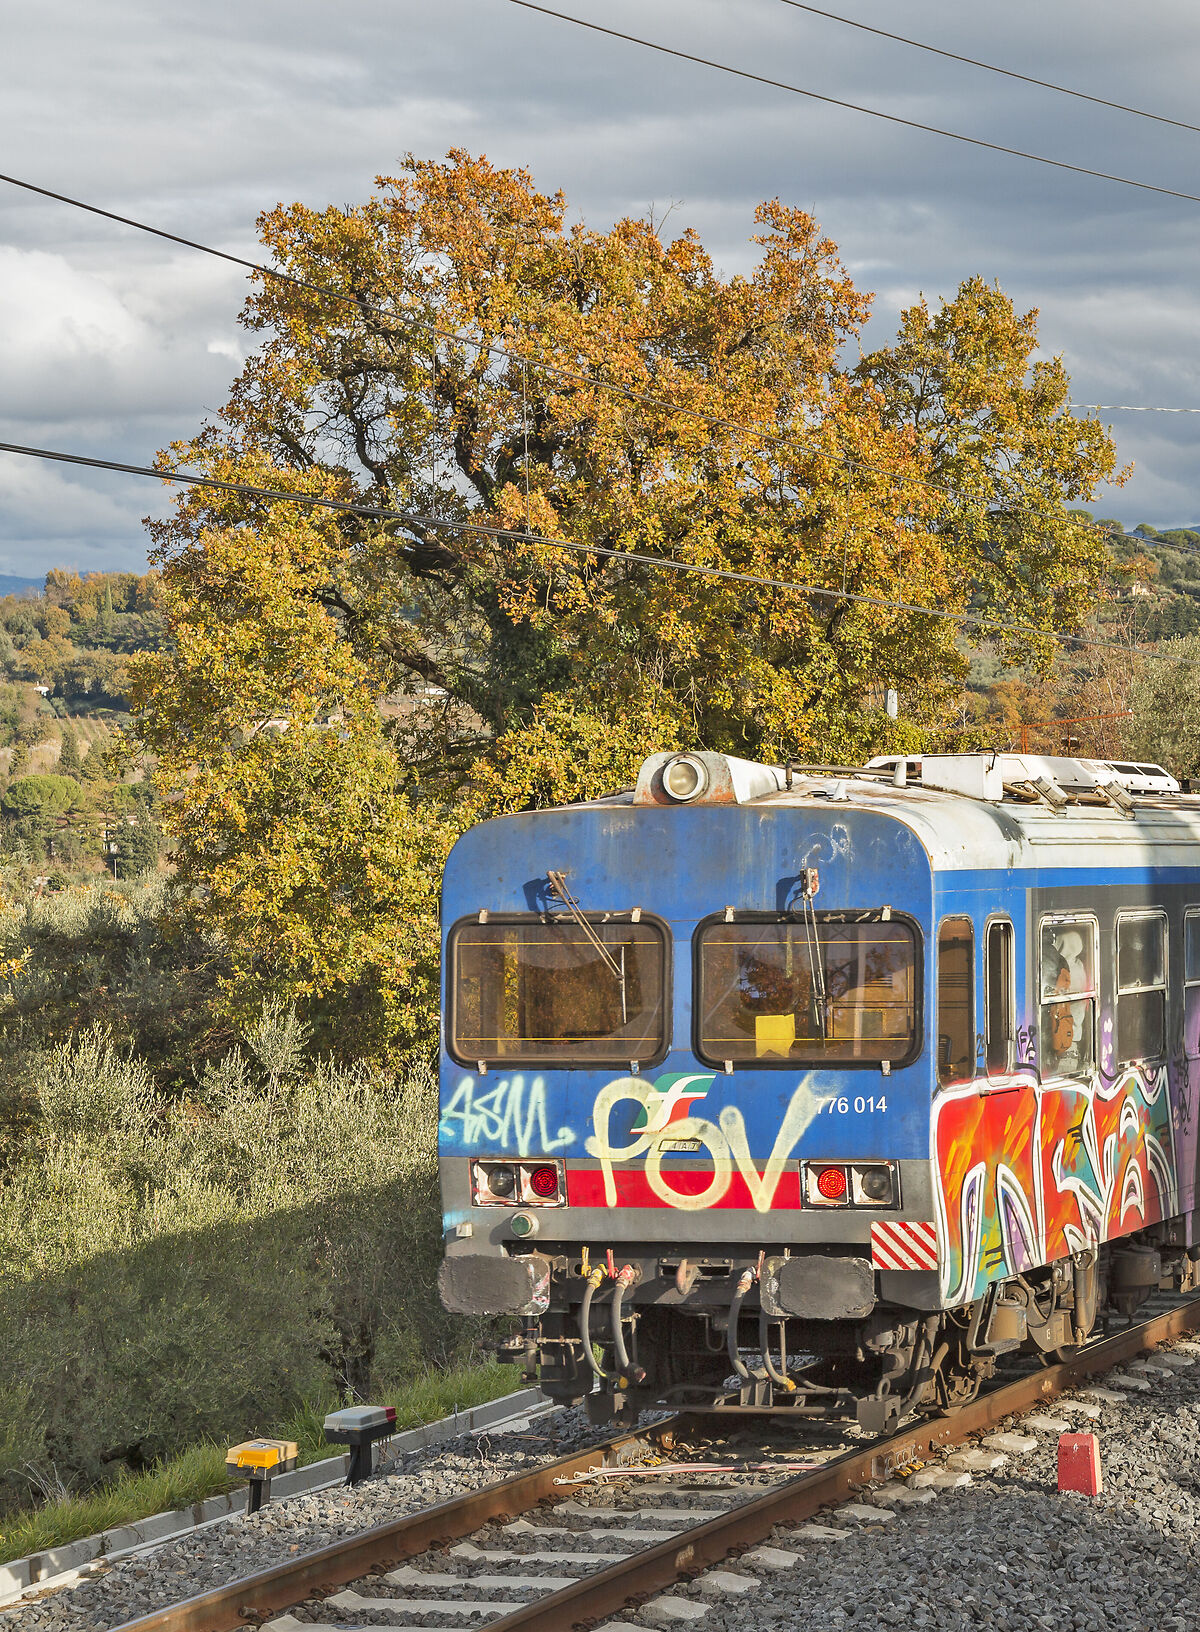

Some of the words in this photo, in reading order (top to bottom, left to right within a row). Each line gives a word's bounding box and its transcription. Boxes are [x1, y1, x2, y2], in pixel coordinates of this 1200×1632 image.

[584, 1071, 840, 1213] POV
[815, 1096, 849, 1114] 776
[854, 1095, 888, 1114] 014
